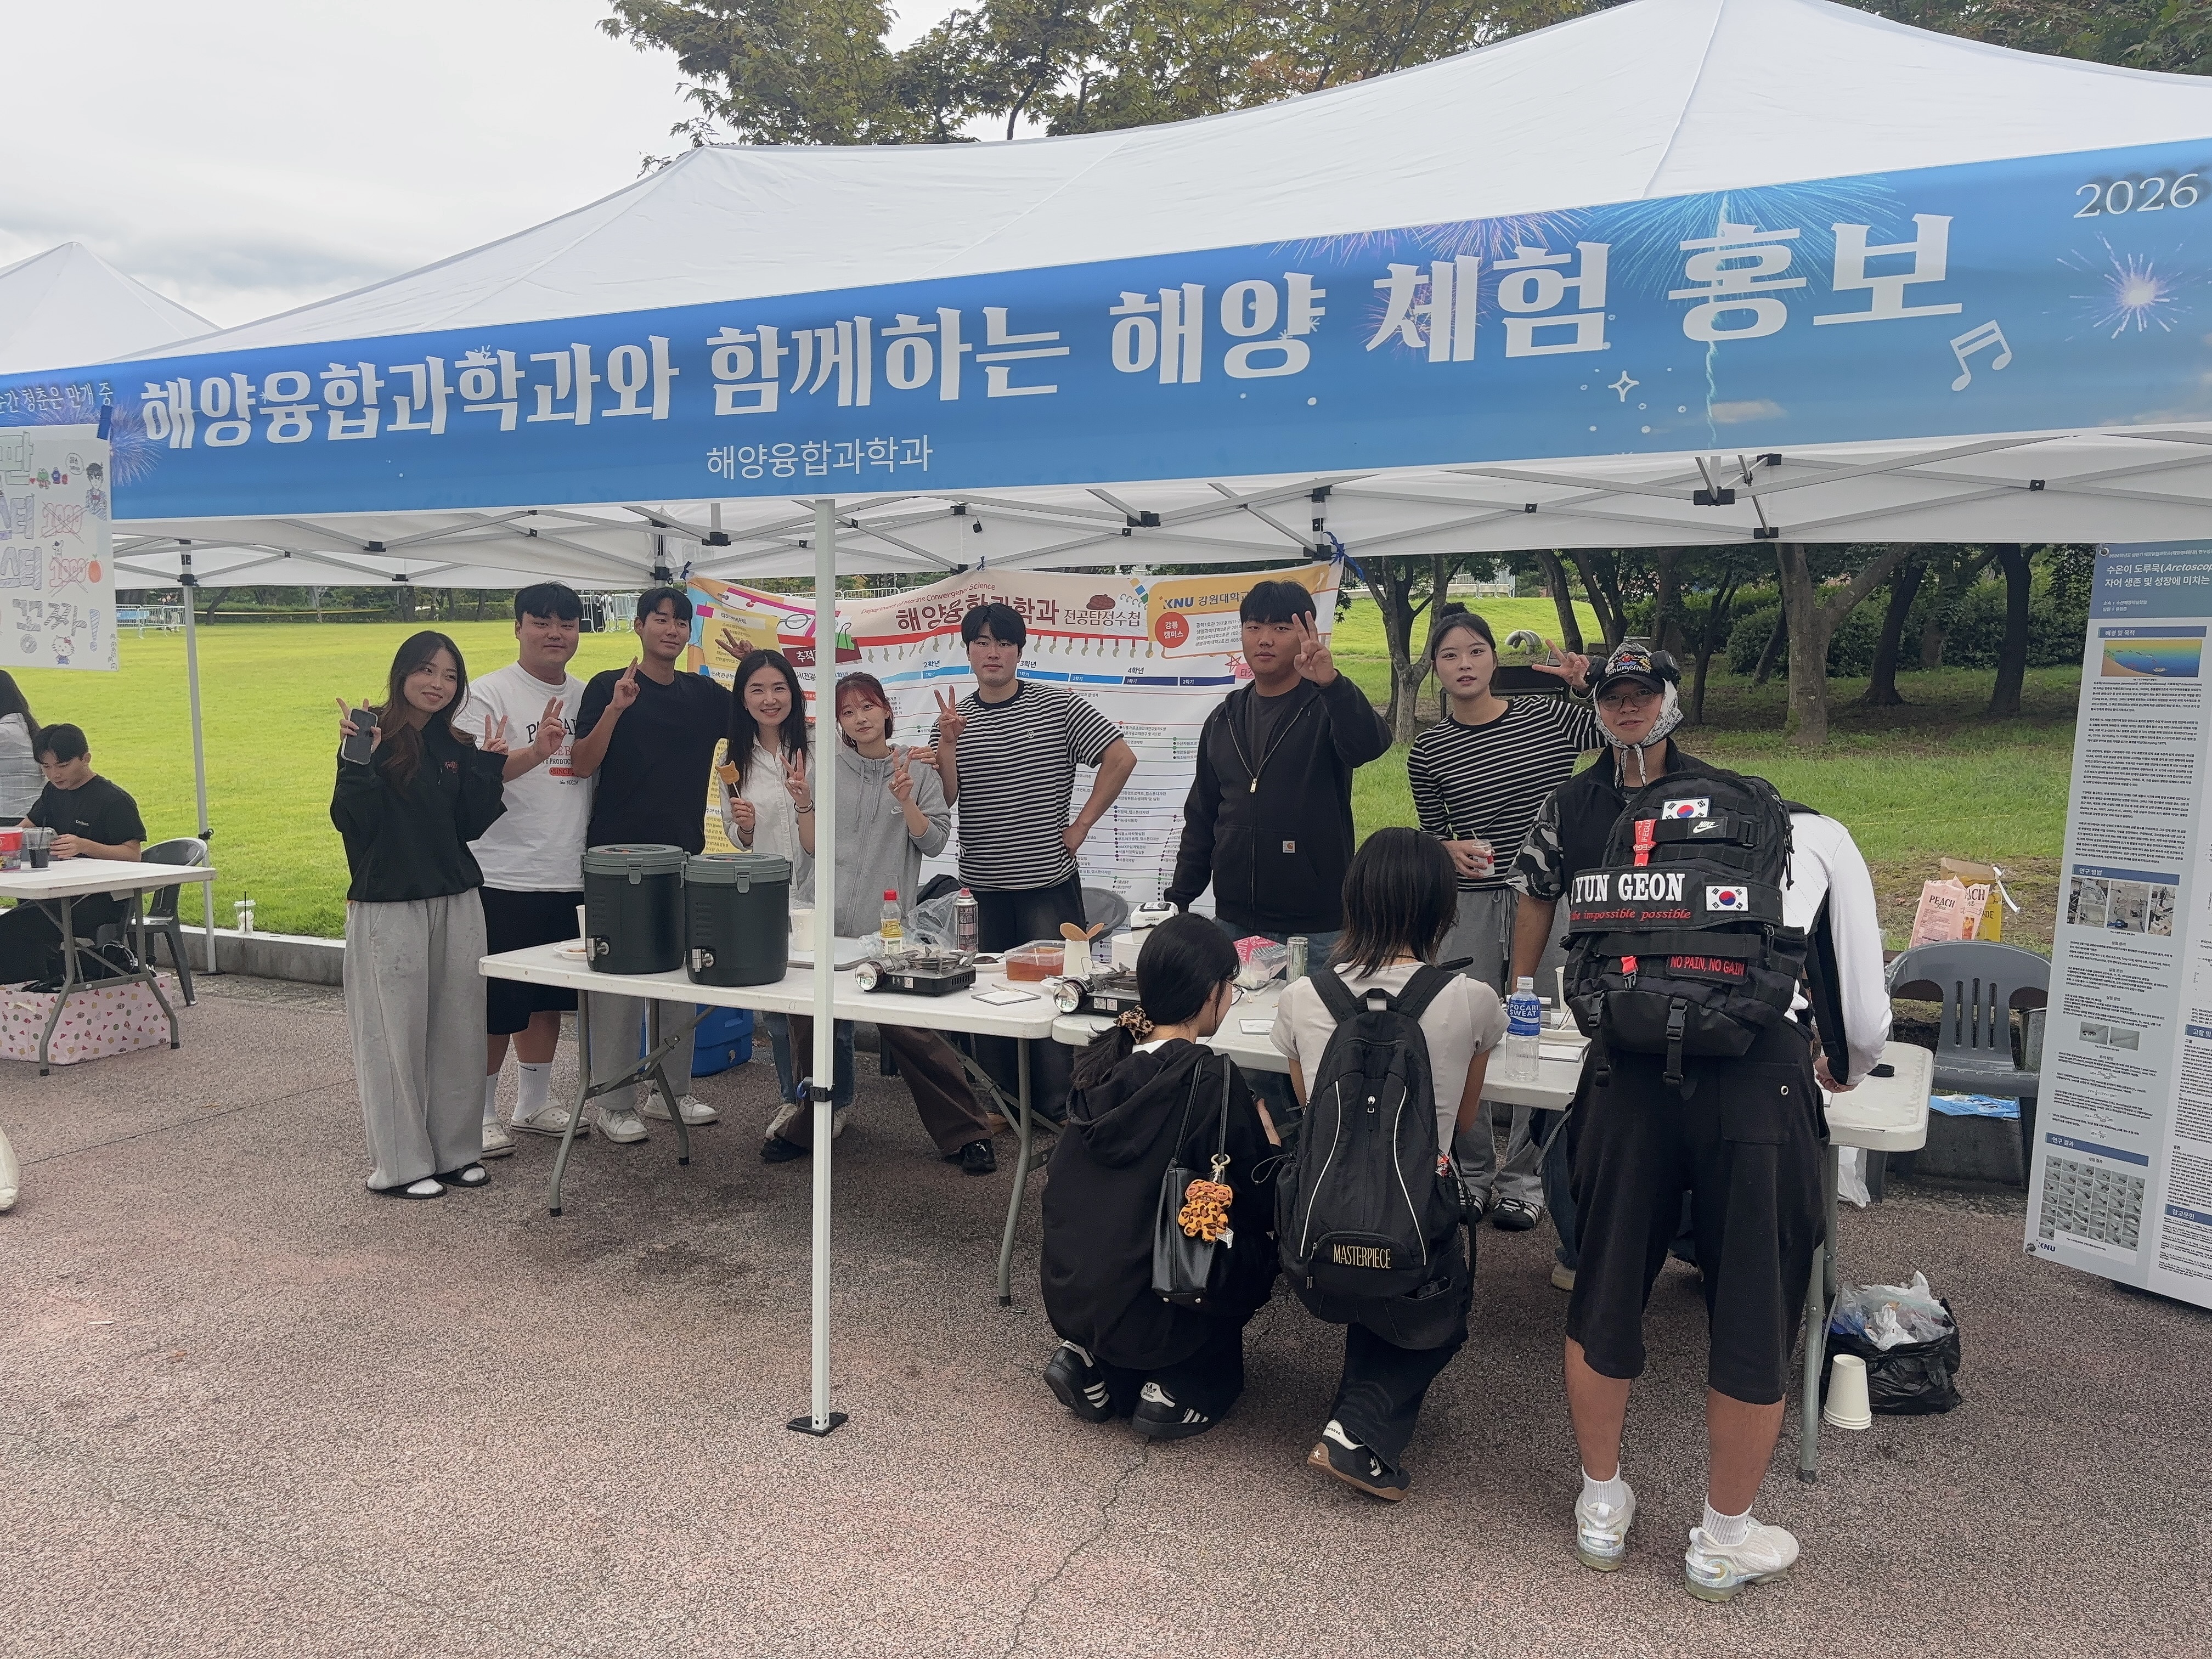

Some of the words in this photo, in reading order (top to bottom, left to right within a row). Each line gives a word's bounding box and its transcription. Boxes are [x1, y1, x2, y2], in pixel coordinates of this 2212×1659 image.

[2073, 173, 2198, 218] 2026
[140, 335, 680, 448] 해양융합과학과와
[706, 306, 1069, 416] 함께하는
[1109, 272, 1326, 384] 해양
[1365, 241, 1611, 363] 체험
[1668, 212, 1962, 342] 홍보
[22, 387, 64, 413] 청춘은
[65, 382, 94, 409] 만개
[99, 382, 114, 407] 중
[706, 435, 933, 480] 해양융합과학과
[2107, 565, 2132, 575] 수온이
[2105, 578, 2122, 588] 자어
[2124, 578, 2141, 587] 생존
[2144, 577, 2152, 586] 및
[2154, 575, 2181, 586] 성장에
[2183, 574, 2210, 585] 미치는
[904, 596, 926, 606] Marine
[969, 582, 996, 591] Science
[1163, 597, 1194, 610] KNU
[1064, 609, 1141, 627] 전공탐정수첩
[1165, 621, 1179, 630] 강릉
[1163, 630, 1184, 639] 캠퍼스
[923, 660, 940, 668] 2학년
[1019, 660, 1037, 668] 3학년
[1127, 667, 1144, 675] 4학년
[1570, 874, 1610, 906] YUN
[1618, 873, 1685, 902] GEON
[1929, 895, 1956, 908] PEACH
[1583, 909, 1636, 923] impossible
[1640, 908, 1692, 921] possible
[1670, 956, 1683, 968] NO
[1684, 956, 1707, 972] PAIN,
[1708, 958, 1722, 972] NO
[1723, 961, 1745, 976] GAIN
[2038, 1243, 2056, 1252] KNU
[1333, 1243, 1392, 1269] MASTERPIECE
